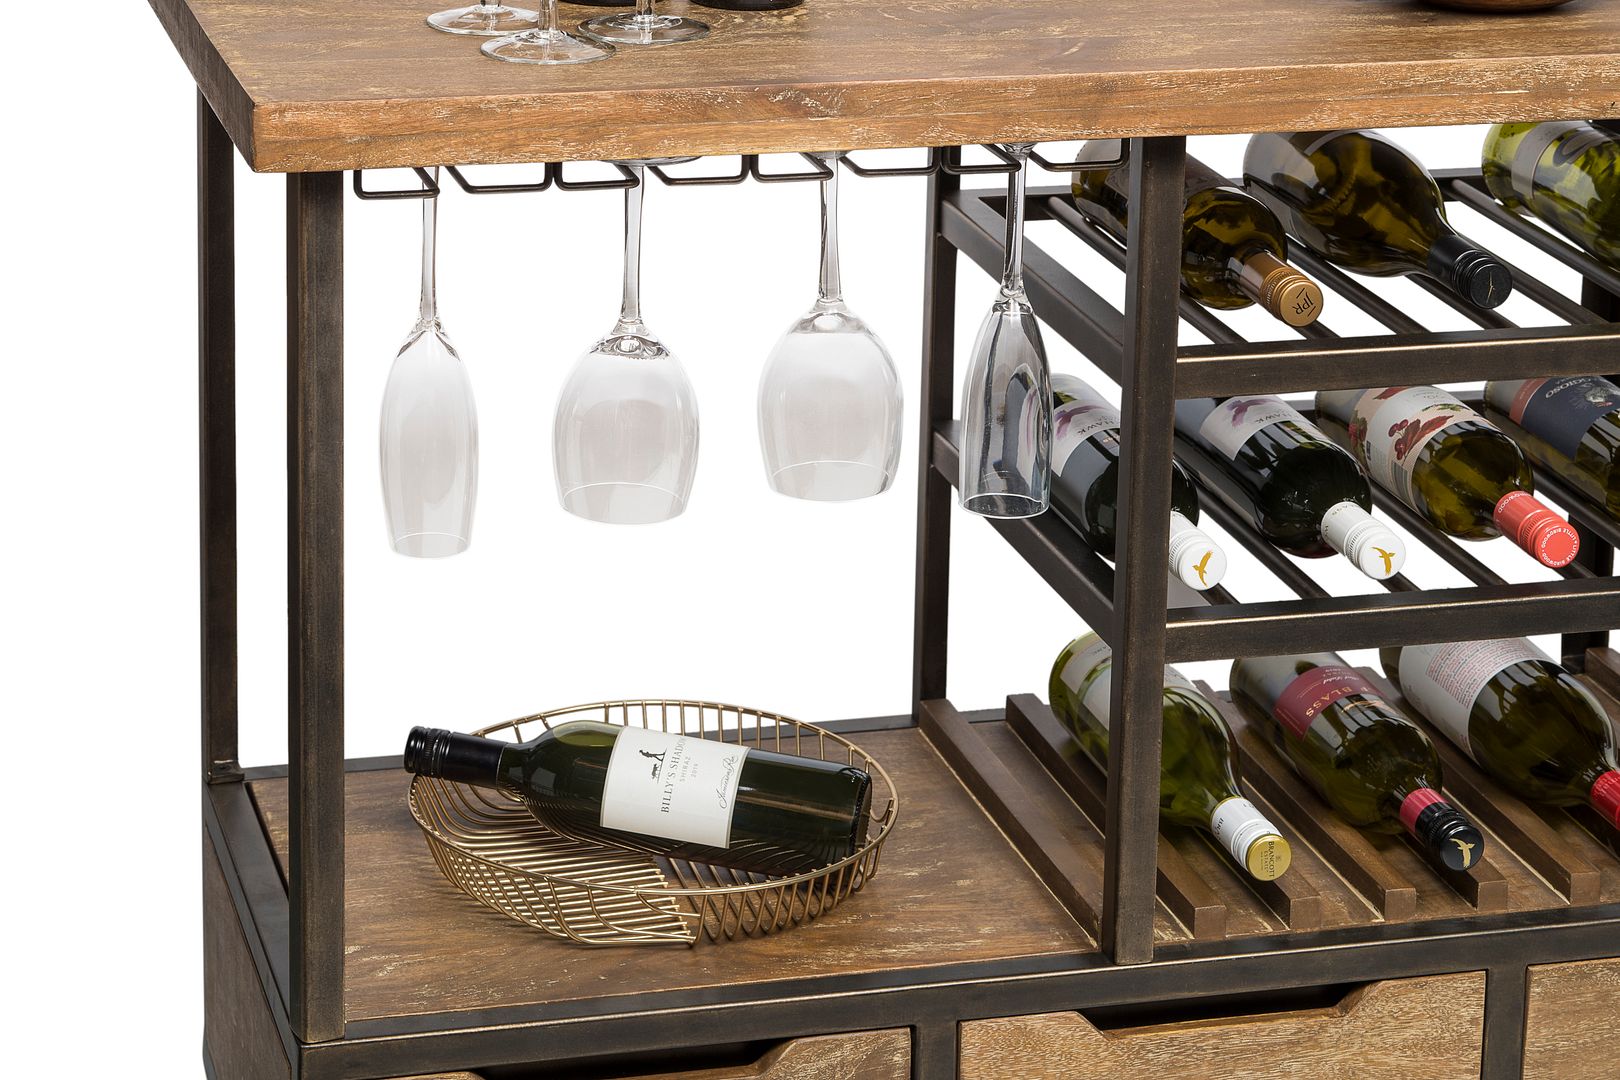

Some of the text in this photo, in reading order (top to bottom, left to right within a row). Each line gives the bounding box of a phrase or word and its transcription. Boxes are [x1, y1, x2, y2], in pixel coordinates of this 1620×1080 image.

[1292, 292, 1314, 315] JPR
[1306, 686, 1352, 717] BLASS
[680, 757, 691, 782] SHIRAZ
[660, 772, 676, 813] BILLY'S
